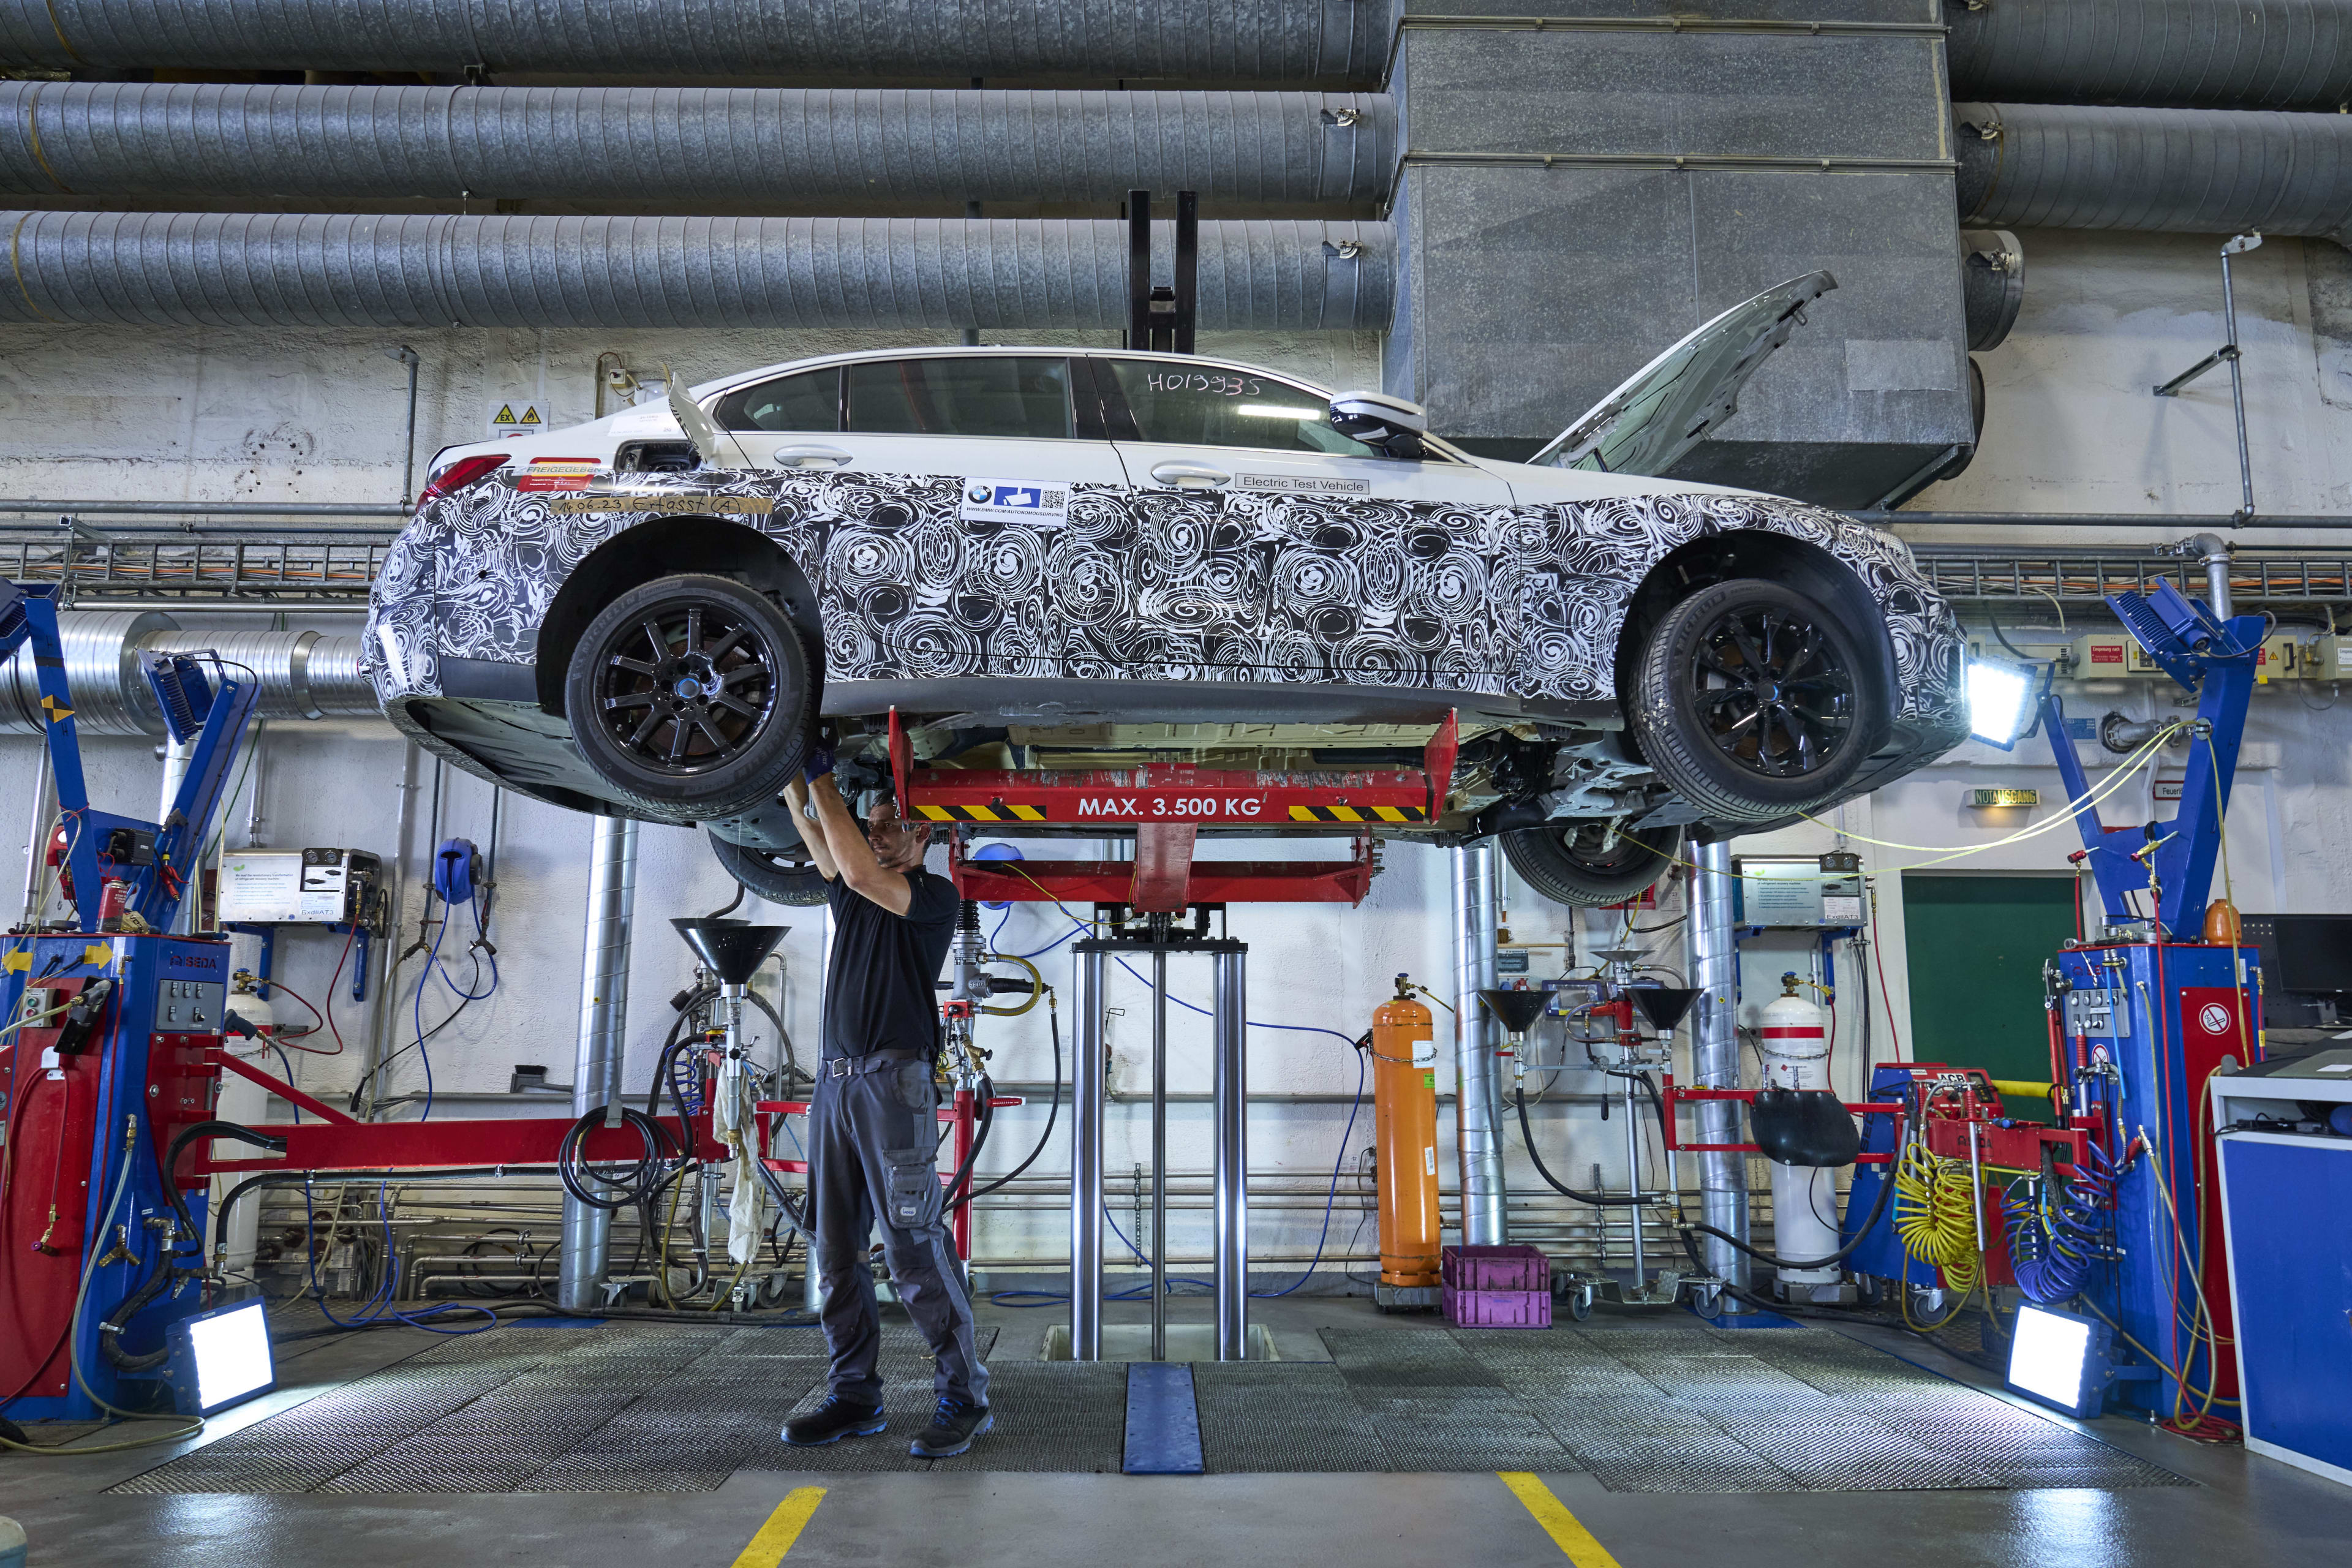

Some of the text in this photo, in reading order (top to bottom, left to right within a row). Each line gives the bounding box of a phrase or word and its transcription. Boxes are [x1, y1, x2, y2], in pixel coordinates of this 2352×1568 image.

[1243, 476, 1363, 491] Electric Test Vehicle
[559, 499, 622, 513] 14.06.23
[633, 496, 704, 513] Erfasst
[967, 507, 1063, 518] WWW.BMW.COM/AUTONOMOUSDRIVING
[1975, 790, 2037, 804] NOTAUSGANG
[1078, 798, 1261, 815] MAX. 3.500 KG
[186, 956, 216, 969] SEDA
